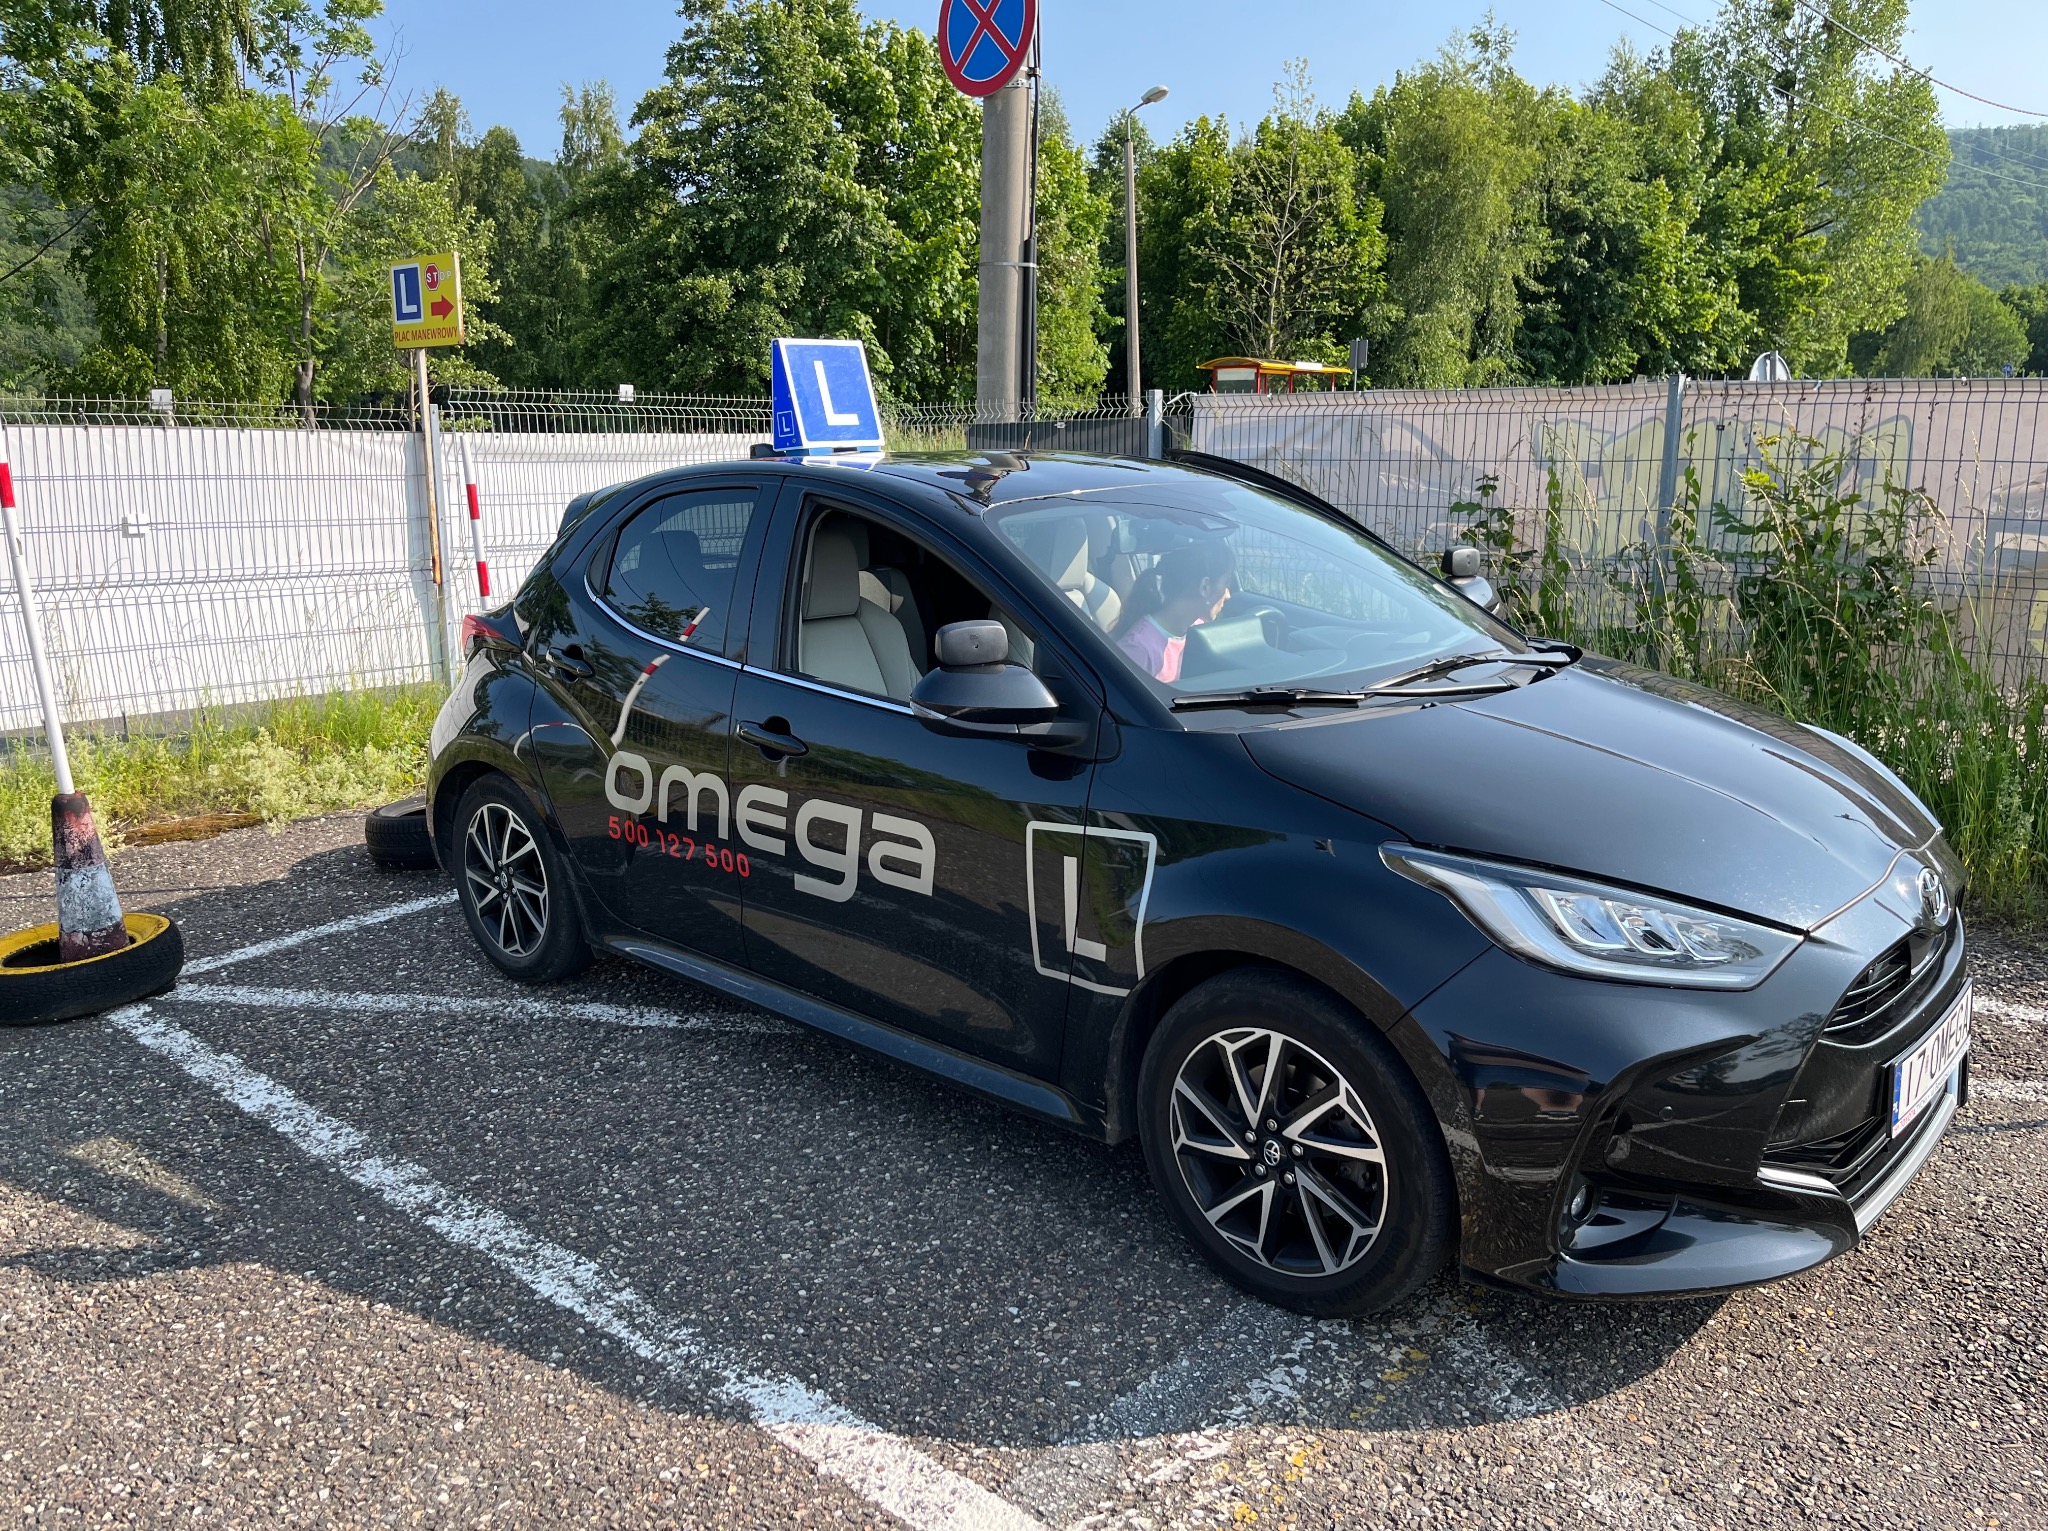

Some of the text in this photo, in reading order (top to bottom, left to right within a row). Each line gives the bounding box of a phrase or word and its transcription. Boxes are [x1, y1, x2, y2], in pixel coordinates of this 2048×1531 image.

[400, 273, 417, 313] L
[426, 270, 452, 283] STOP
[394, 326, 458, 342] PLAC MANEWROWY
[813, 360, 860, 426] L
[782, 416, 791, 433] L
[608, 815, 750, 878] 500 127 500
[1063, 855, 1107, 963] L
[1929, 994, 1969, 1080] OMEGA
